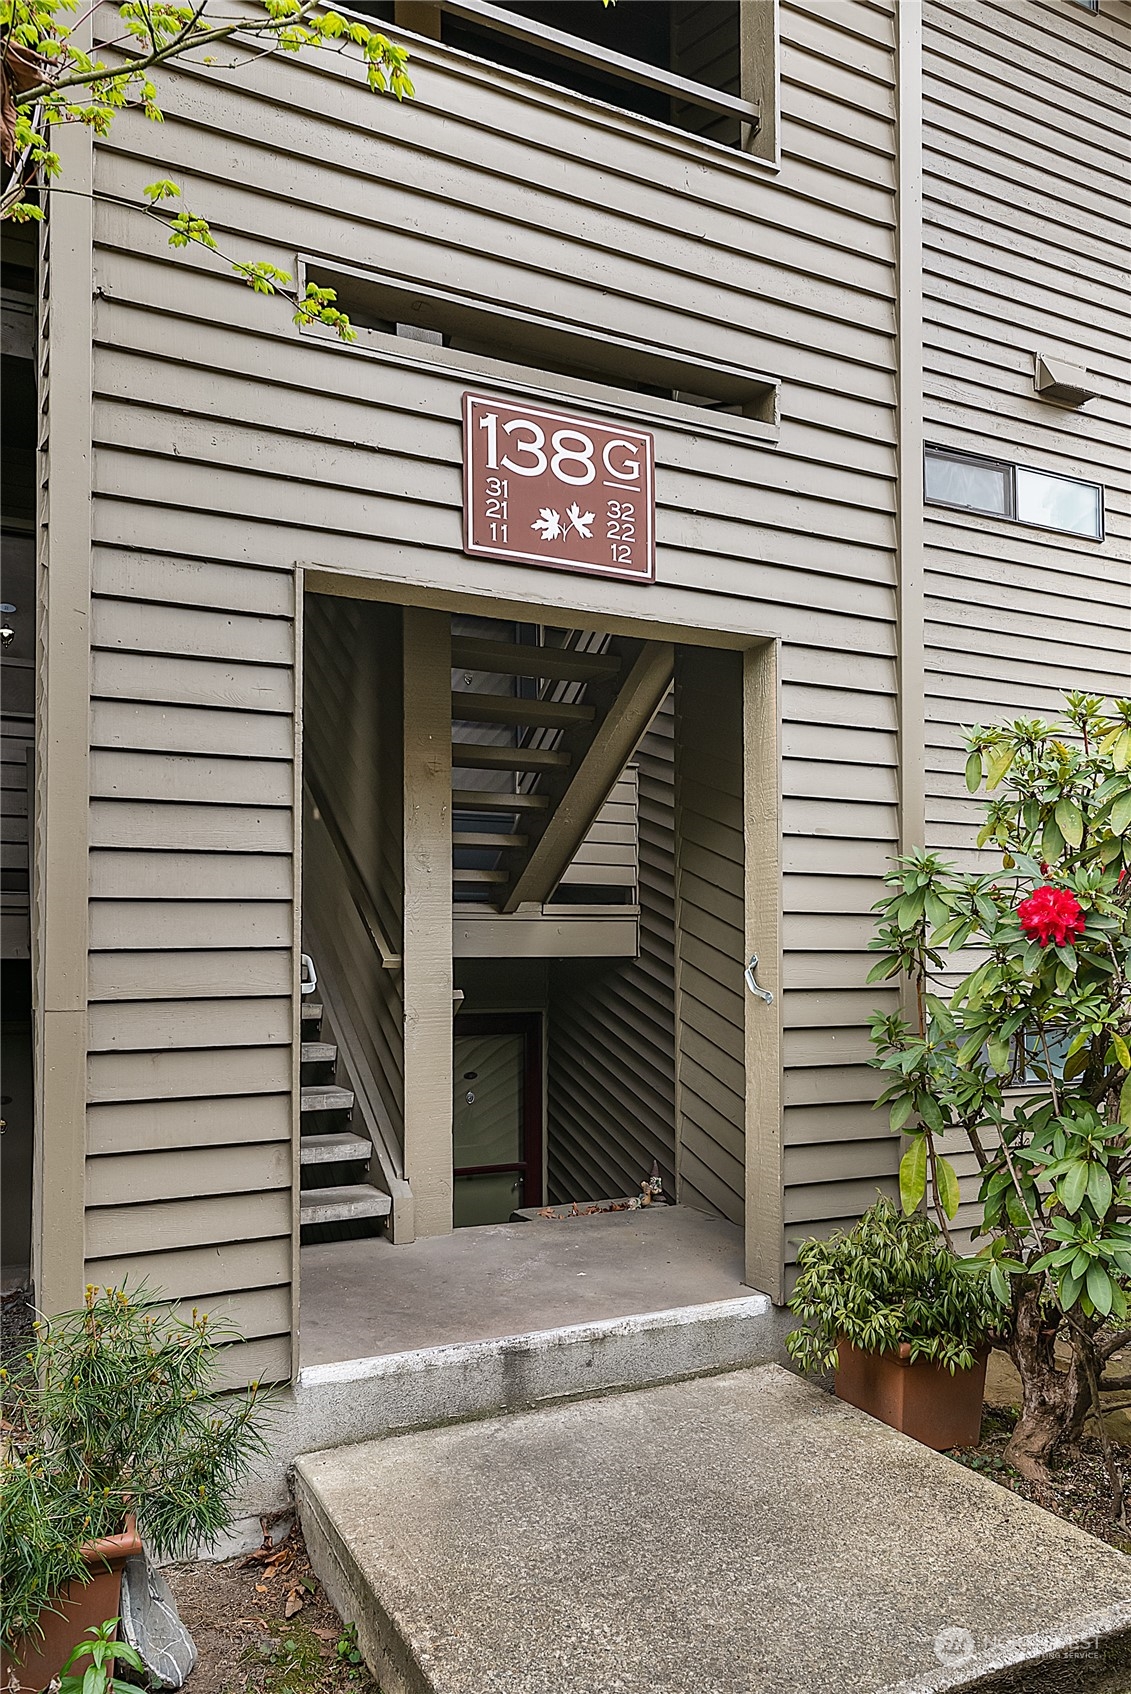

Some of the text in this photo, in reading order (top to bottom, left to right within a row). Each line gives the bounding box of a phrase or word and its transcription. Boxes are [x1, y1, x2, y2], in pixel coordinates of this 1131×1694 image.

[485, 476, 509, 498] 31
[485, 499, 508, 520] 21
[606, 500, 636, 522] 32
[489, 522, 508, 543] 11
[606, 520, 636, 543] 22
[610, 543, 632, 564] 12
